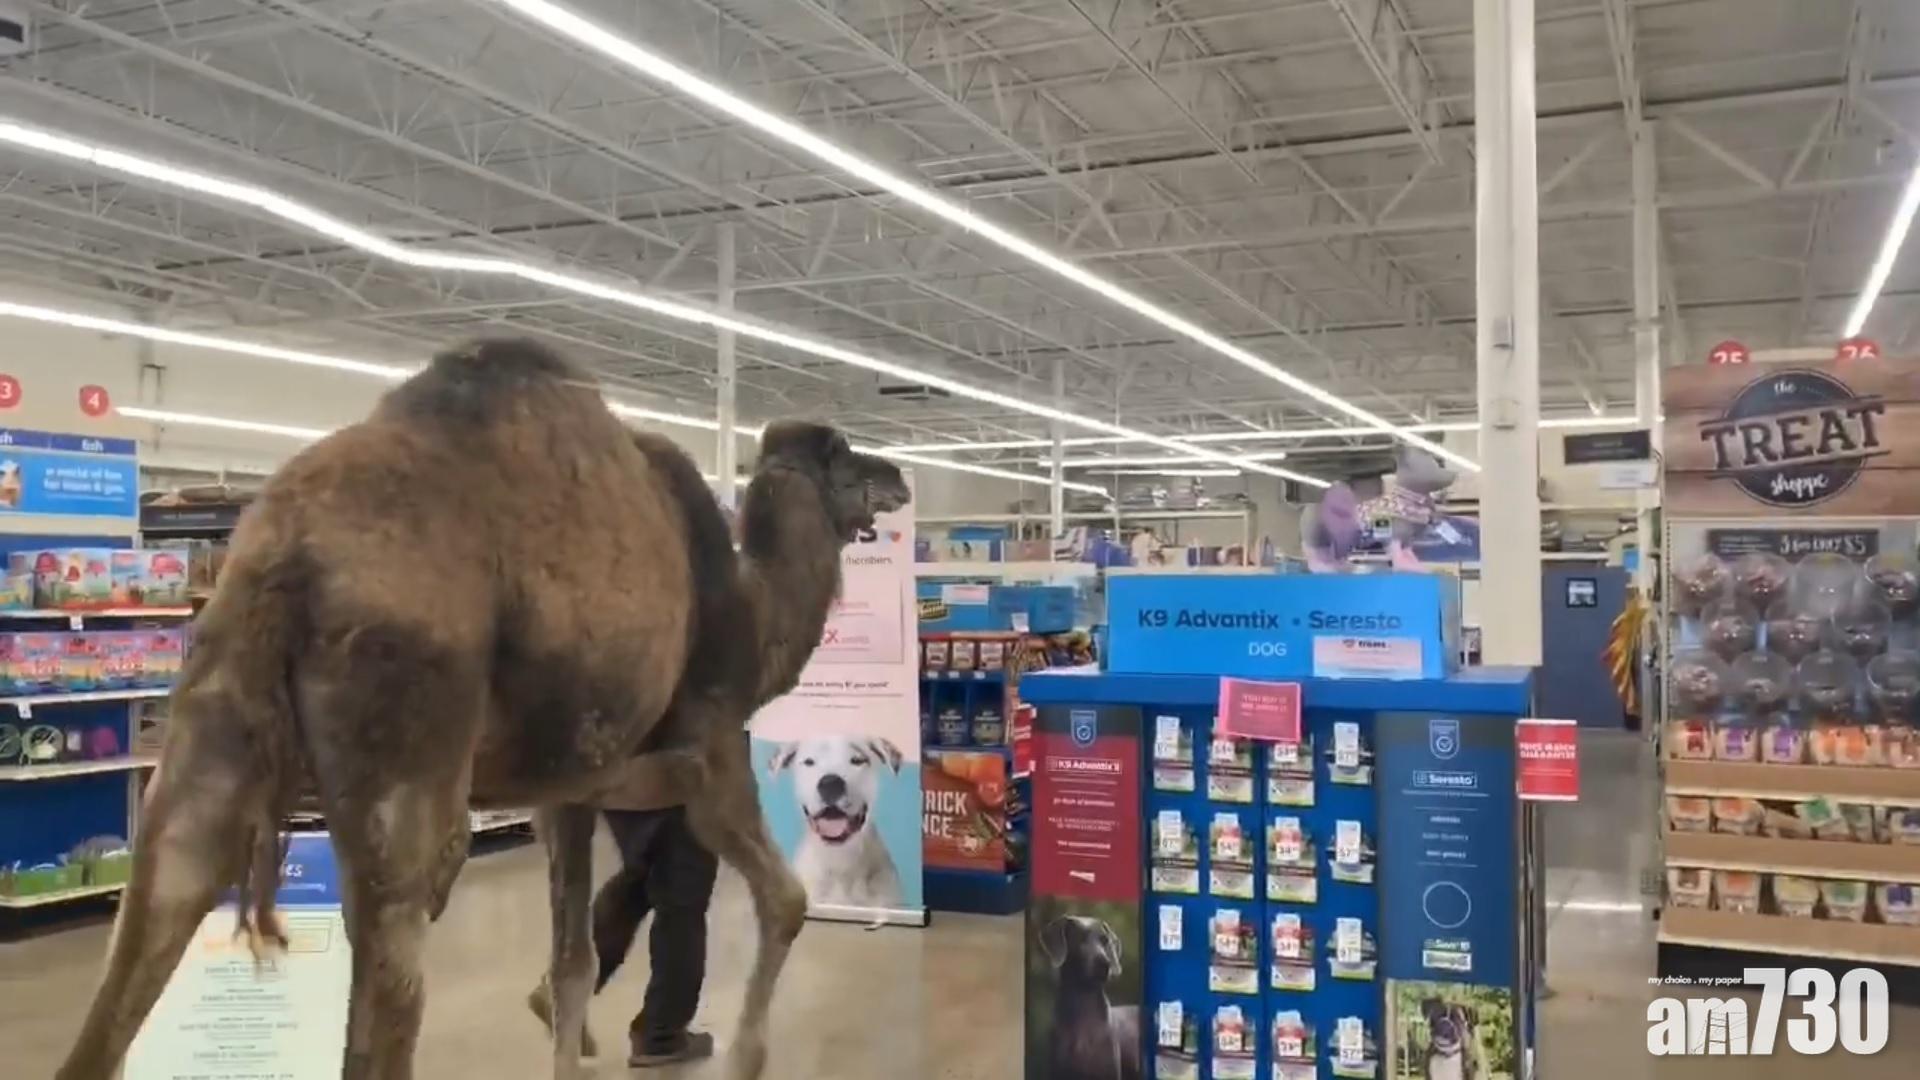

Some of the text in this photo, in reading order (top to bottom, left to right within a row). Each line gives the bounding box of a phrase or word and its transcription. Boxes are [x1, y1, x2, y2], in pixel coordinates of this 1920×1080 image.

[1774, 381, 1795, 394] the
[88, 393, 100, 410] 4
[1701, 402, 1885, 470] TREAT
[81, 439, 104, 452] fish
[1770, 473, 1830, 498] shoppe
[1138, 609, 1402, 630] K9 Advantix Seresto
[1248, 642, 1287, 657] DOG
